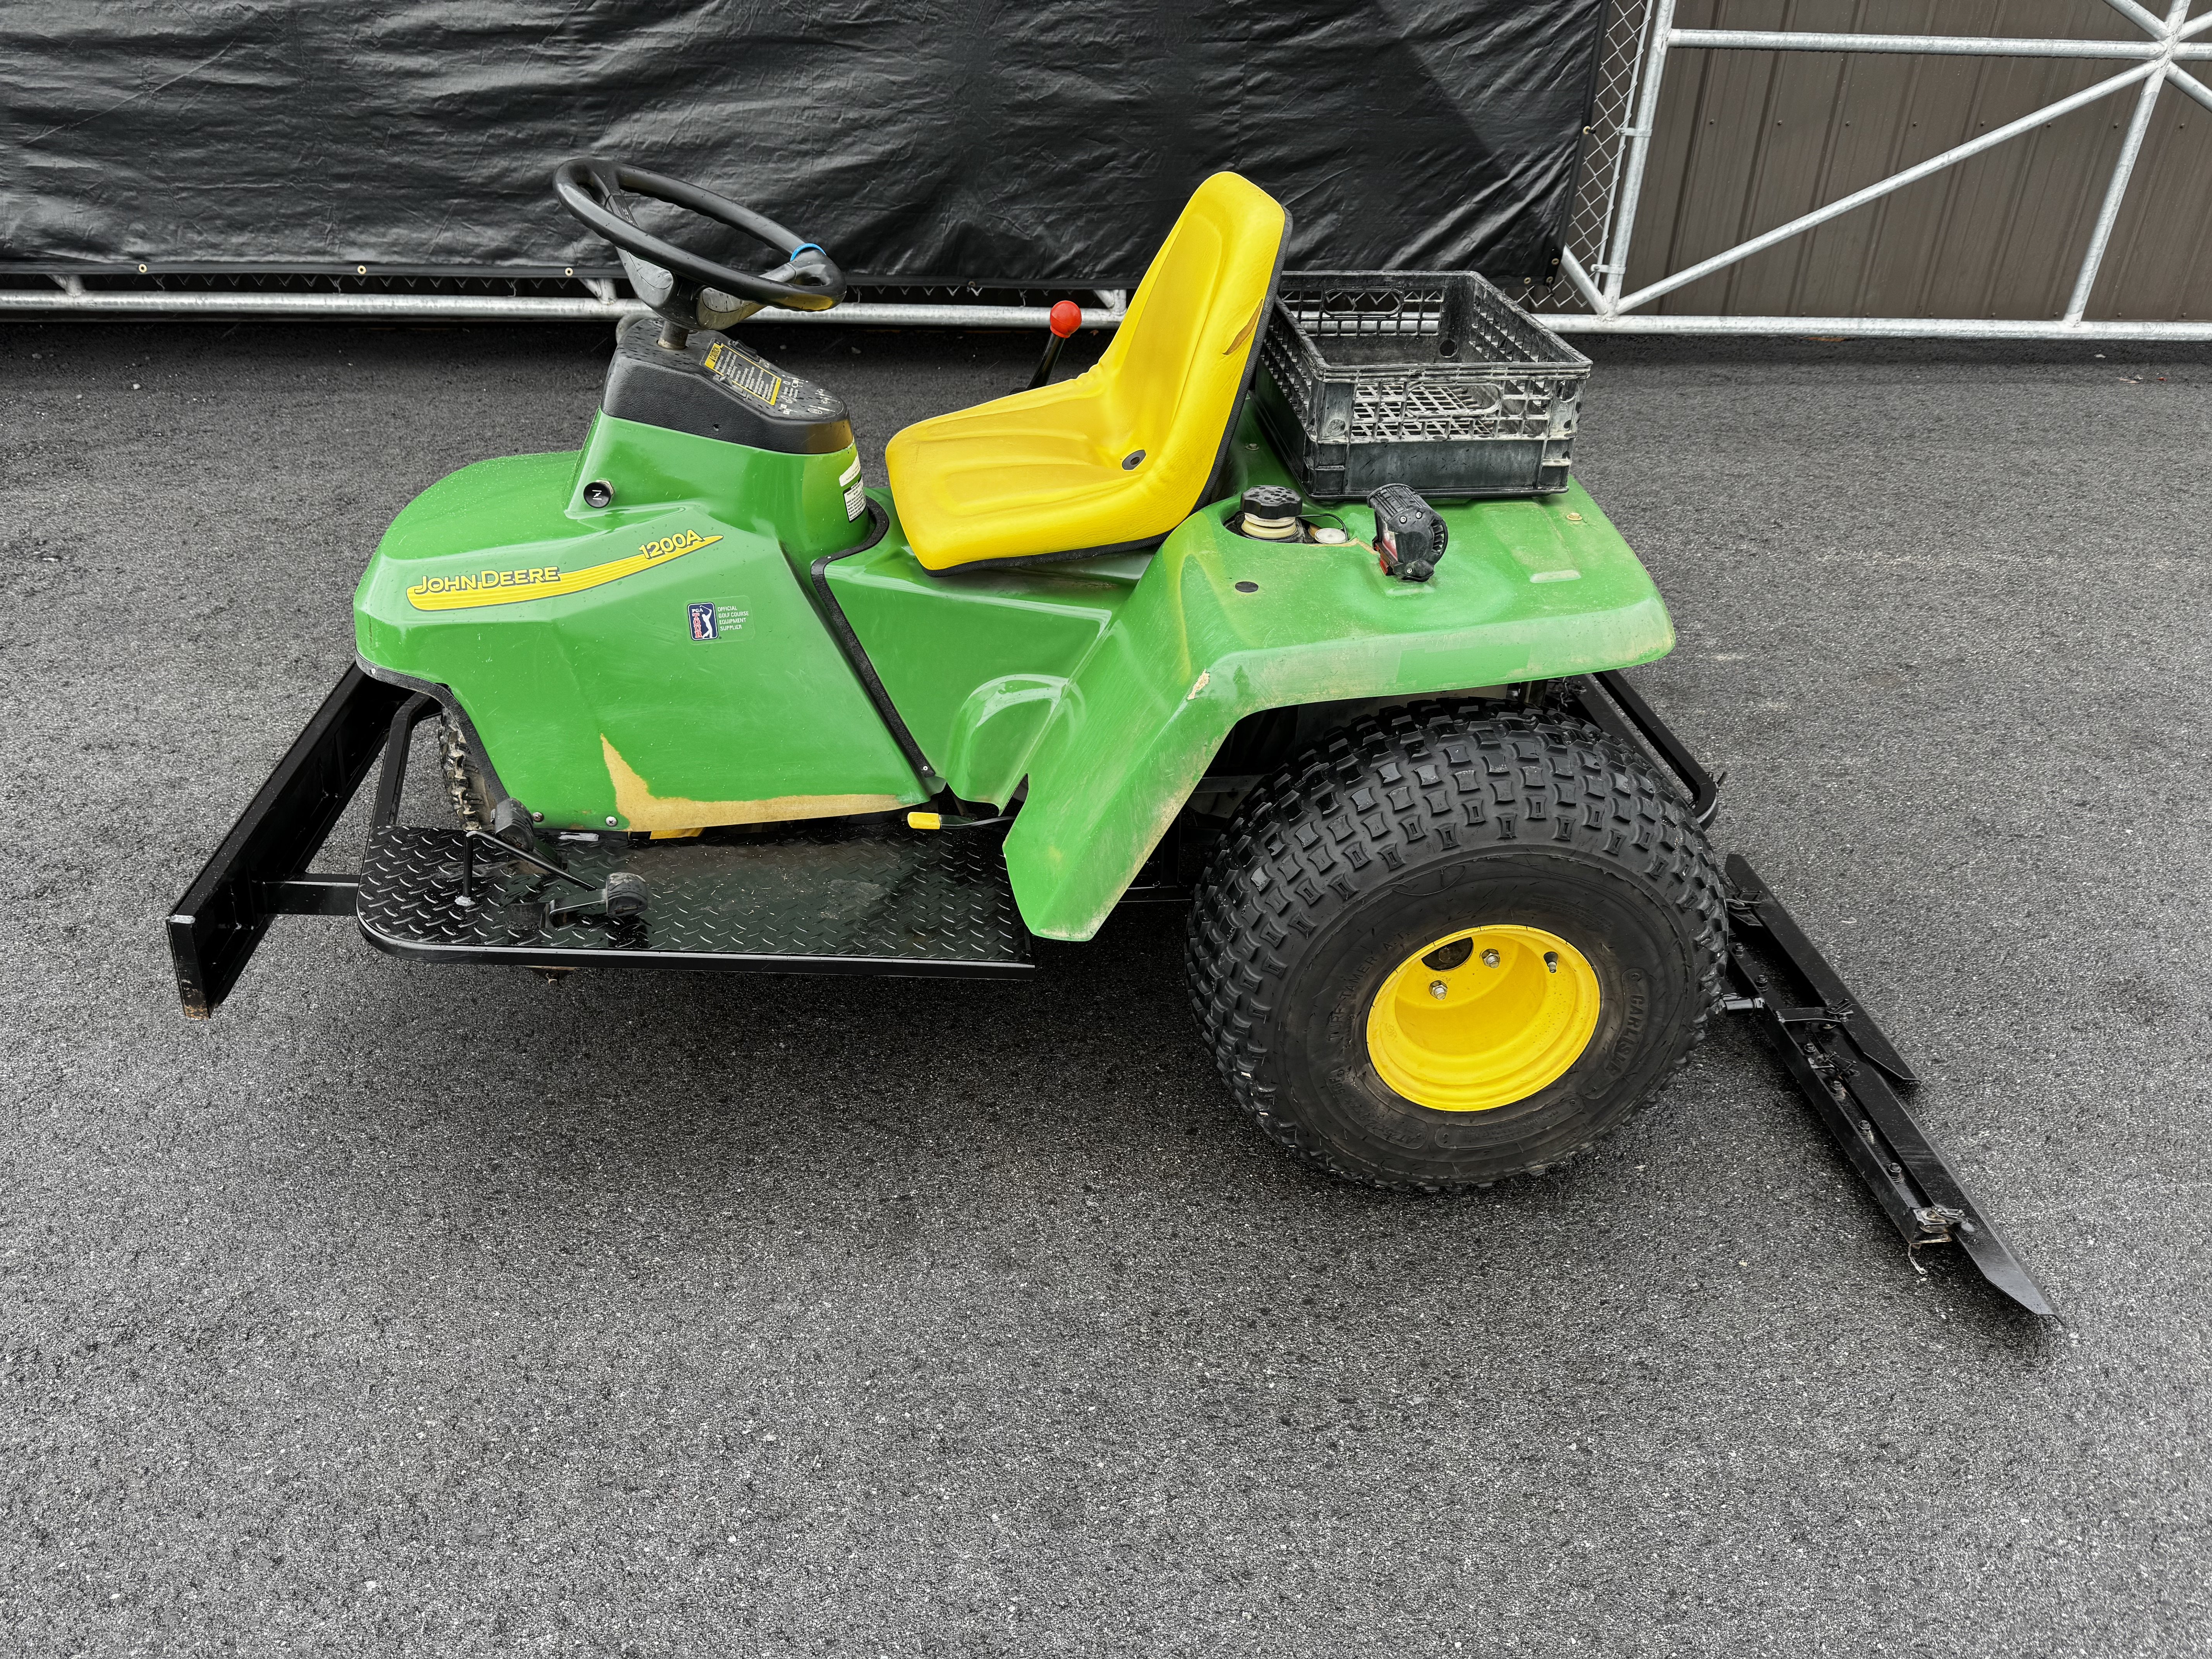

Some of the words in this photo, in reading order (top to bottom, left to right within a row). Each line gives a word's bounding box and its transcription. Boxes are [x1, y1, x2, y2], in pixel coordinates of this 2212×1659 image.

[639, 529, 704, 559] 1200A
[414, 574, 477, 594] JOHN
[481, 567, 560, 589] DEERE
[692, 613, 703, 638] TOUR
[1326, 1007, 1346, 1042] TURF
[1339, 955, 1378, 999] TAMER
[1605, 994, 1646, 1076] CARLISLE
